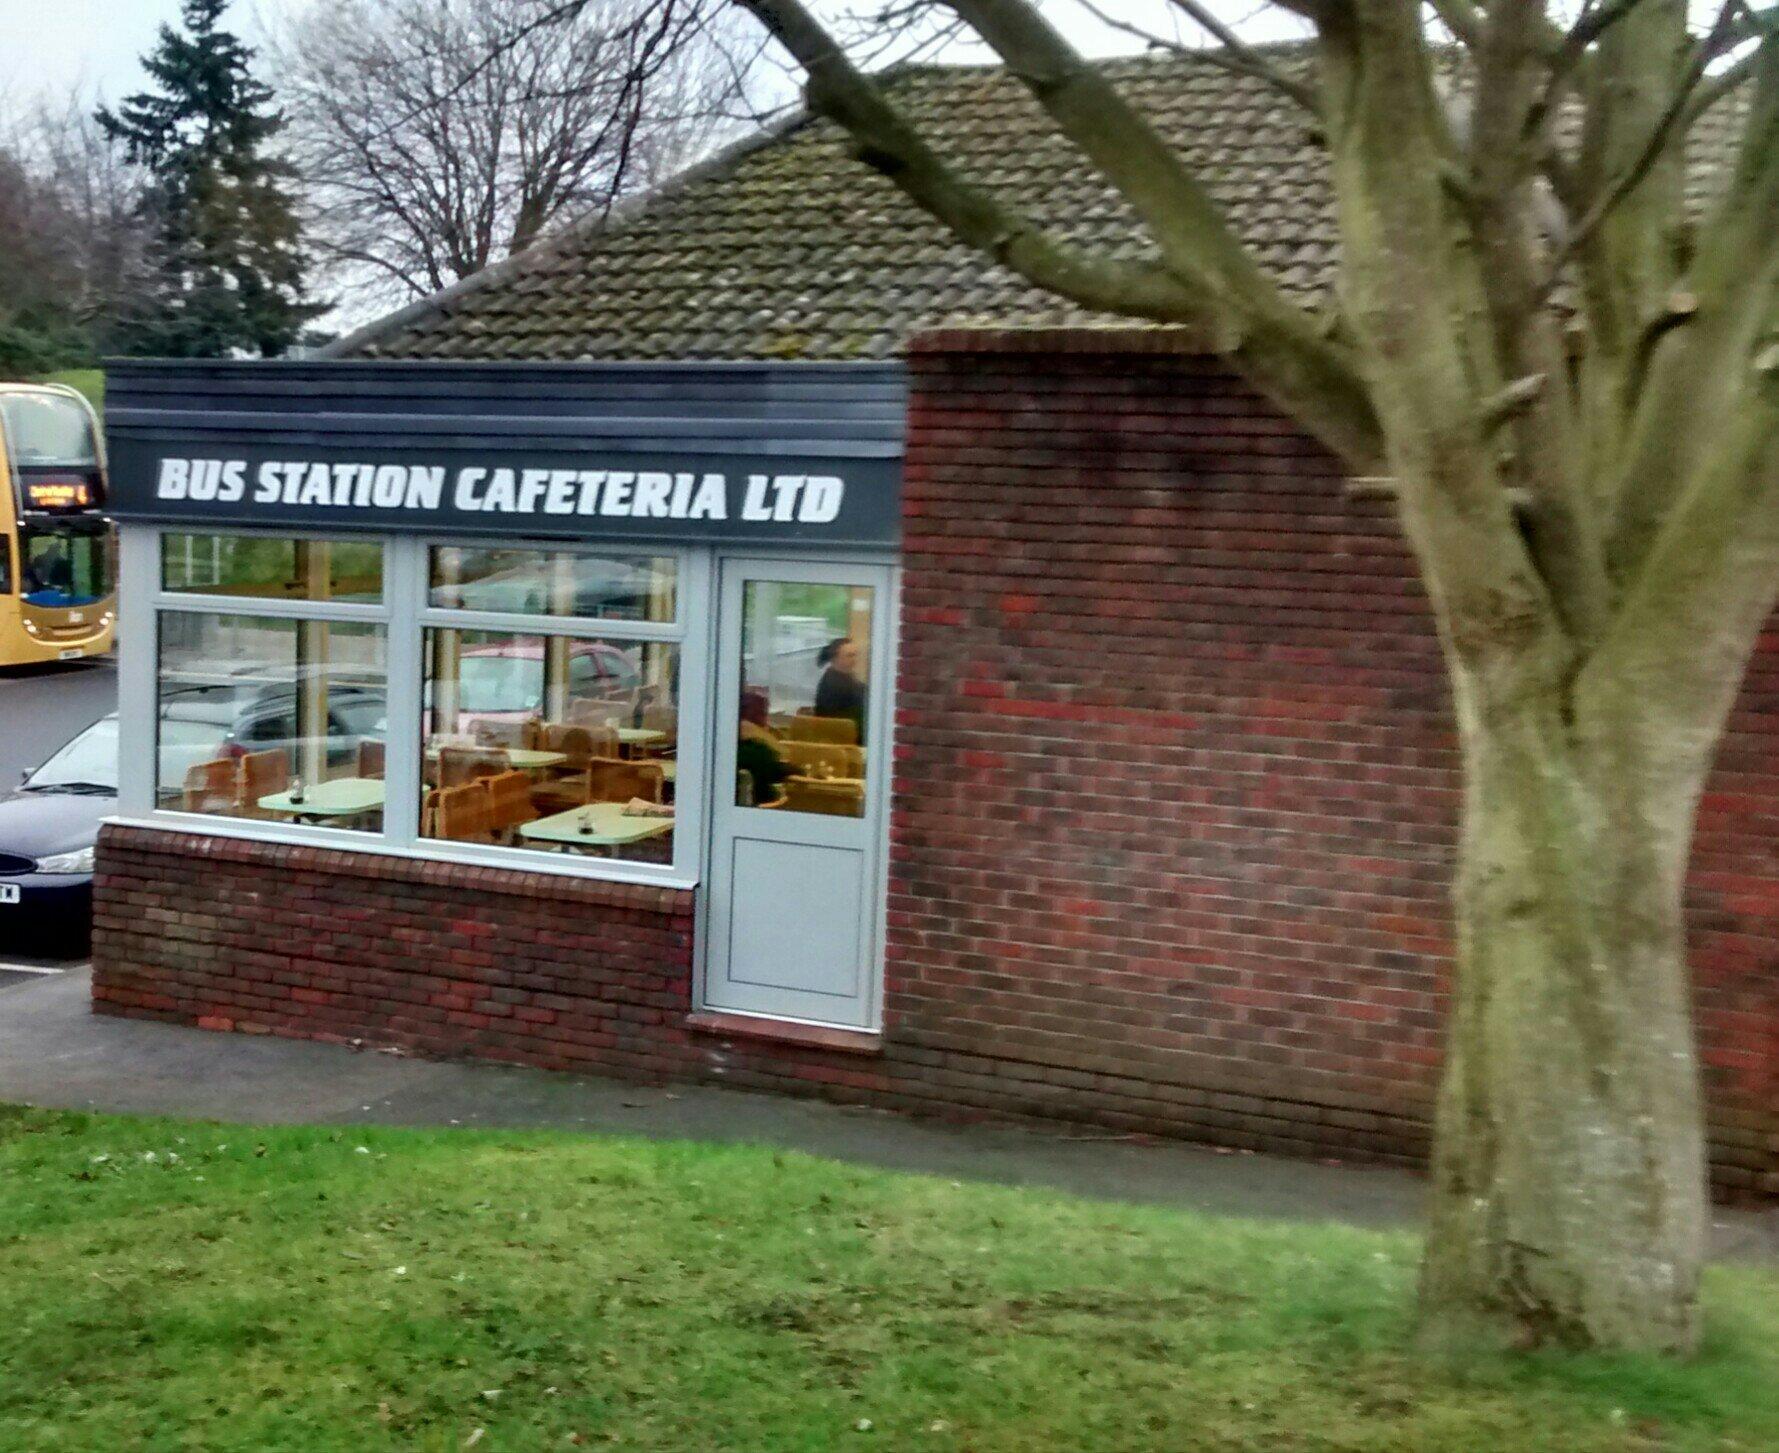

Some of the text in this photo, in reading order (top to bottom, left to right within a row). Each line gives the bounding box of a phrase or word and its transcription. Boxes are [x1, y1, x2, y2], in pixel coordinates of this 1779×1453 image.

[157, 458, 844, 523] BUS STATION CAFETERIA LTD
